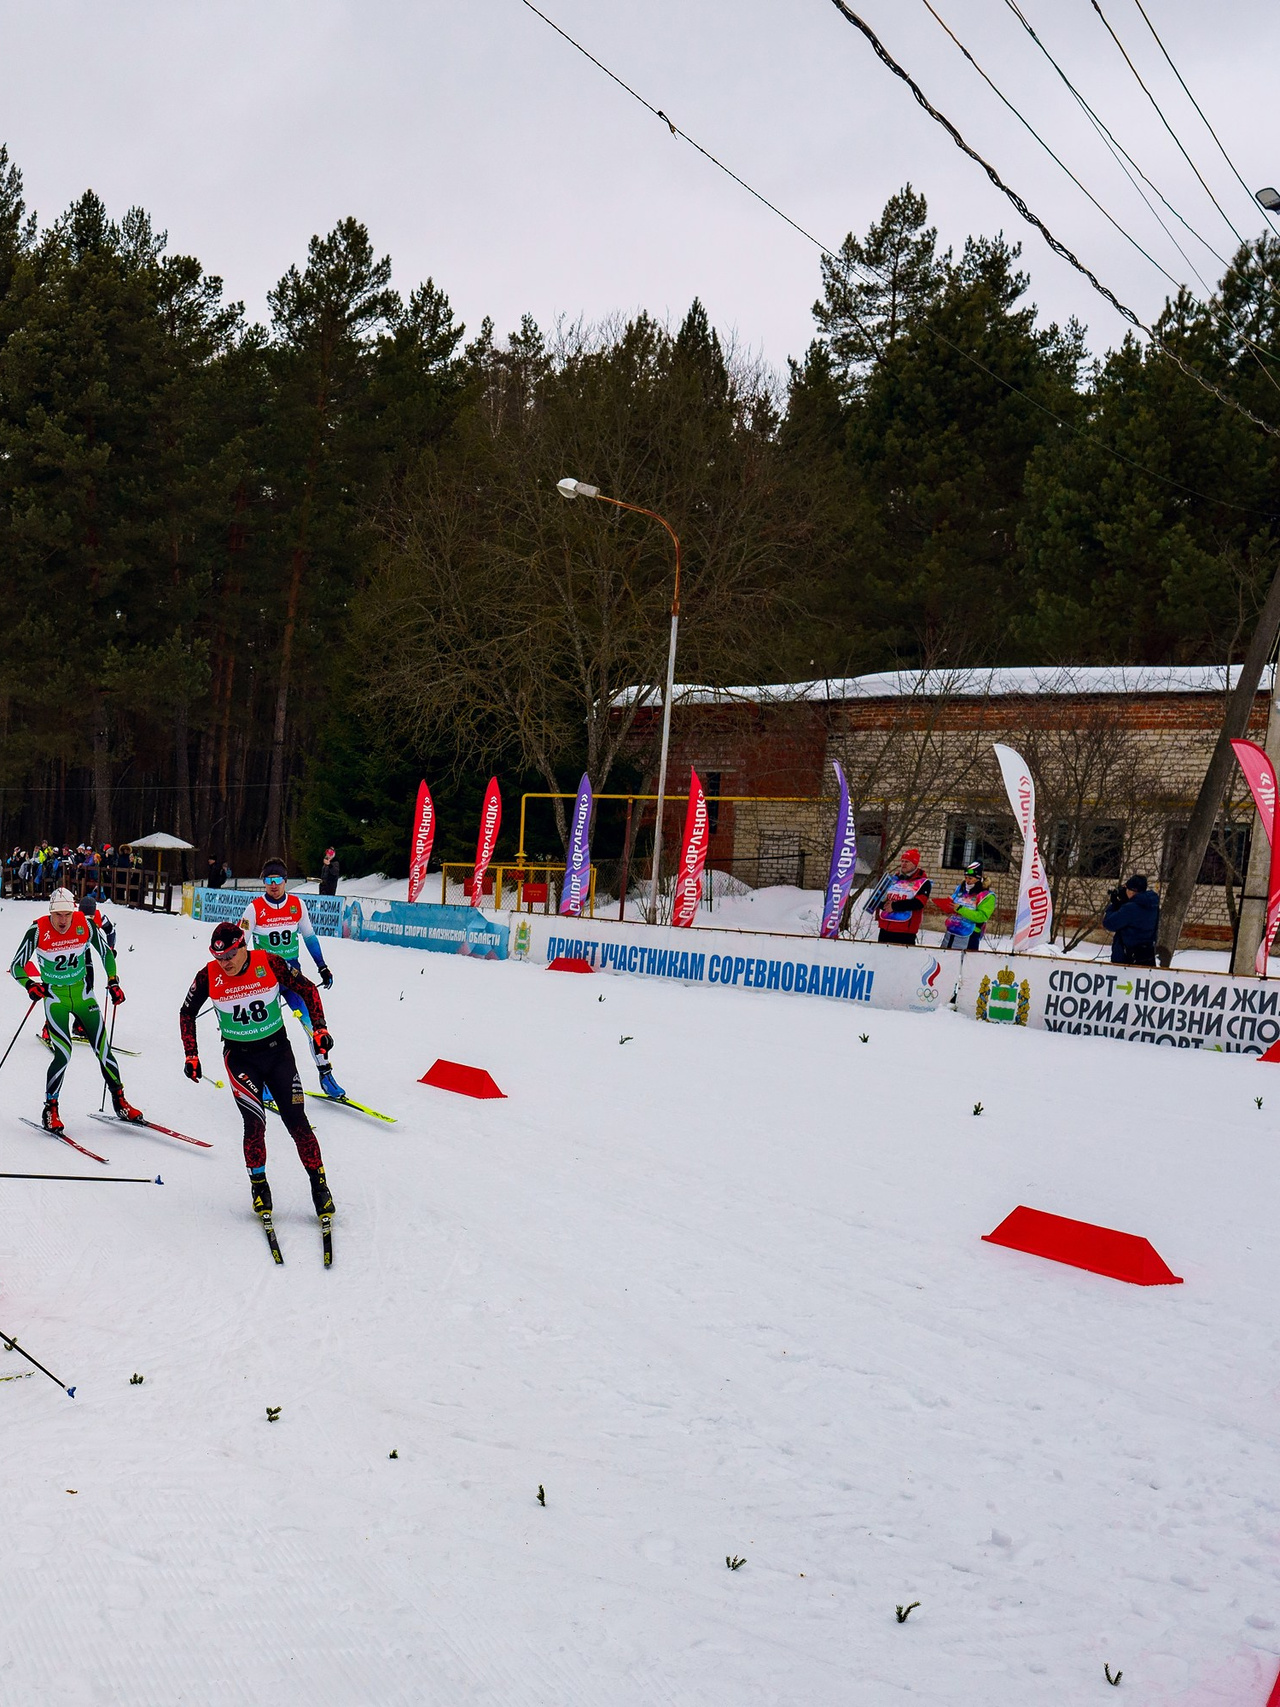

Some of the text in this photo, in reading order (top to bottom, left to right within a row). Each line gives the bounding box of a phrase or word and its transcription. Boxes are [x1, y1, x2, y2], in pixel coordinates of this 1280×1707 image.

[416, 796, 433, 862] «ОРЛЕНОК»
[481, 796, 499, 865] «ОРЛЕНОК»
[570, 794, 589, 912] СШОР «ОРЛЕНОК»
[679, 789, 707, 919] СШОР «ОРЛЕНОК»
[827, 883, 844, 930] СШОР
[1028, 886, 1049, 938] СШОР
[269, 929, 292, 946] 69
[405, 925, 427, 937] СПОРТА
[428, 928, 467, 942] КАЛУЖСКОЙ
[468, 932, 501, 946] ОБЛАСТИ
[54, 953, 79, 971] 24
[547, 937, 875, 1002] ПРИВЕТ УЧАСТНИКАМ СОРЕВНОВАНИЙ!
[225, 982, 261, 994] ФЕДЕРАЦИЯ
[1049, 970, 1280, 1016] СПОРТ НОРМА ЖИ
[233, 1000, 269, 1026] 48
[260, 1018, 281, 1033] ОБЛАСТ
[1044, 994, 1129, 1025] НОРМА
[1131, 1004, 1224, 1037] ЖИЗНИ
